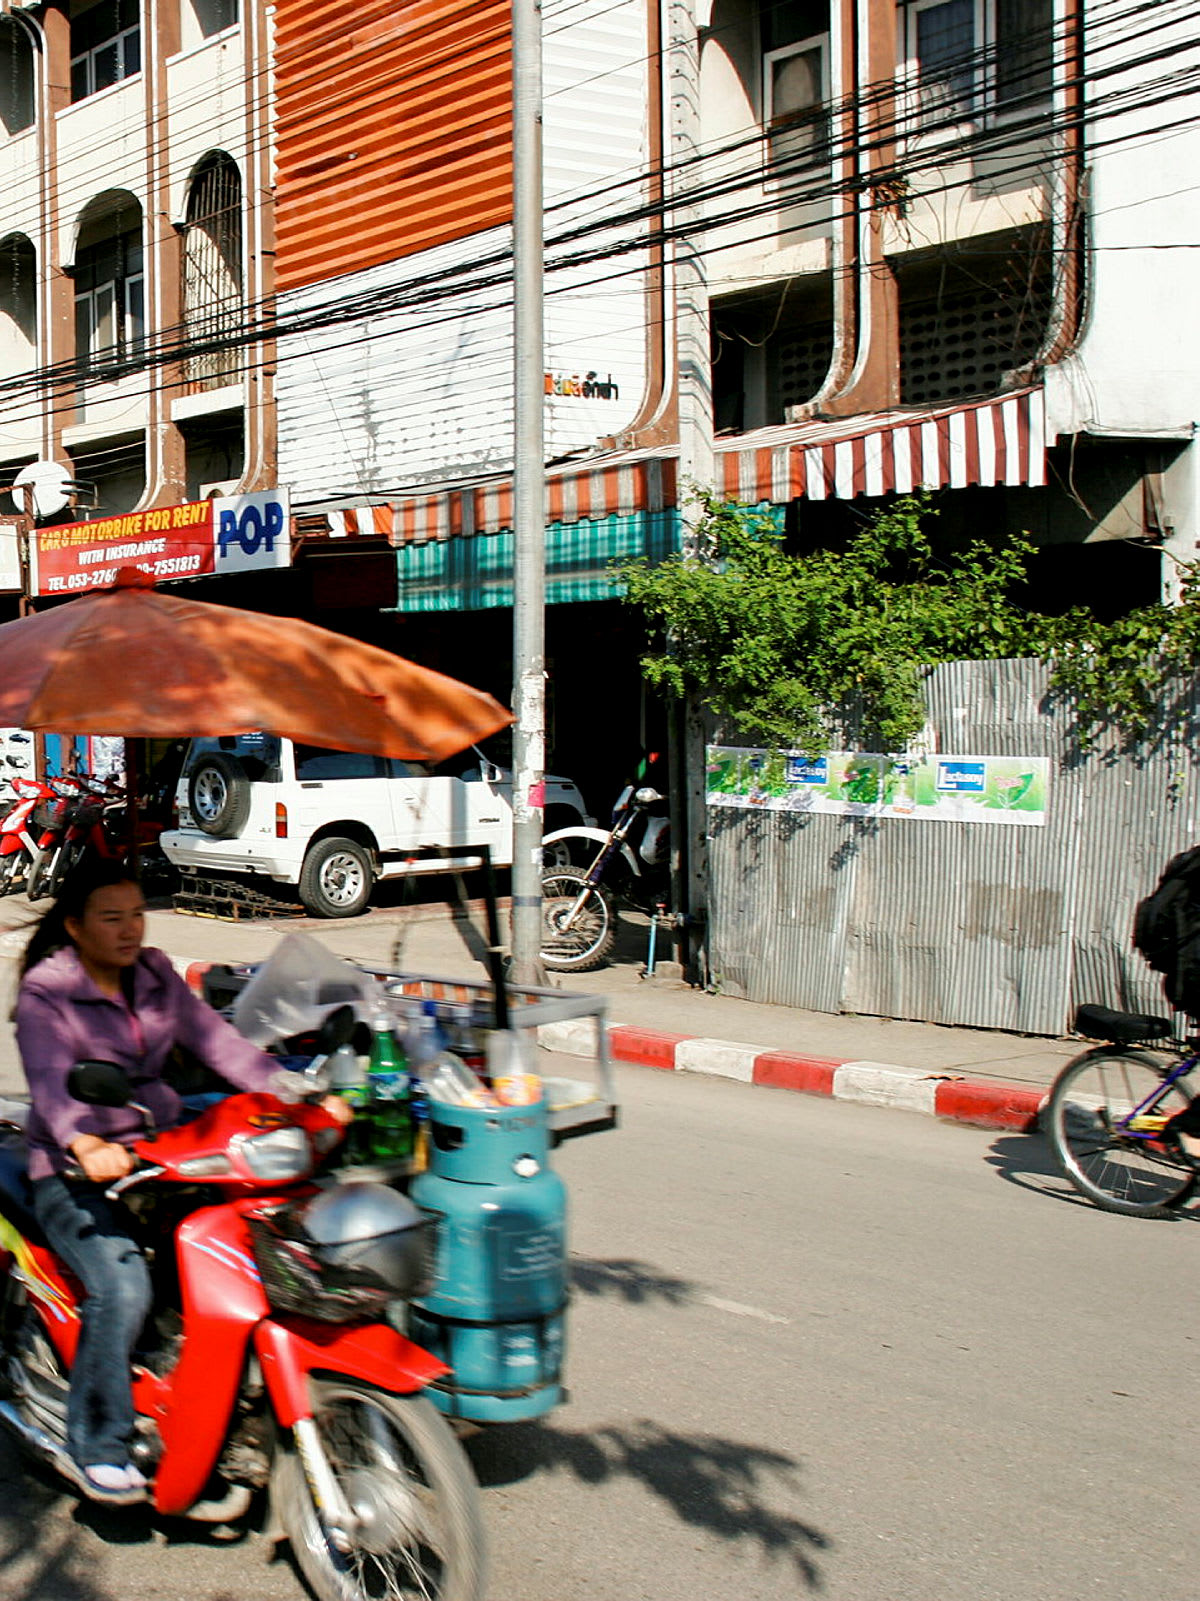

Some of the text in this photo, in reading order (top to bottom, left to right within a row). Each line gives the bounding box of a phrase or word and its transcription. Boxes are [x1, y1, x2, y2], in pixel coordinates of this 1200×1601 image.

[39, 529, 63, 551] CAR
[71, 516, 142, 545] MOTORBIKE
[143, 507, 170, 532] FOR
[173, 501, 210, 528] RENT
[78, 537, 167, 565] WITH INSURANCE
[217, 502, 284, 558] POP
